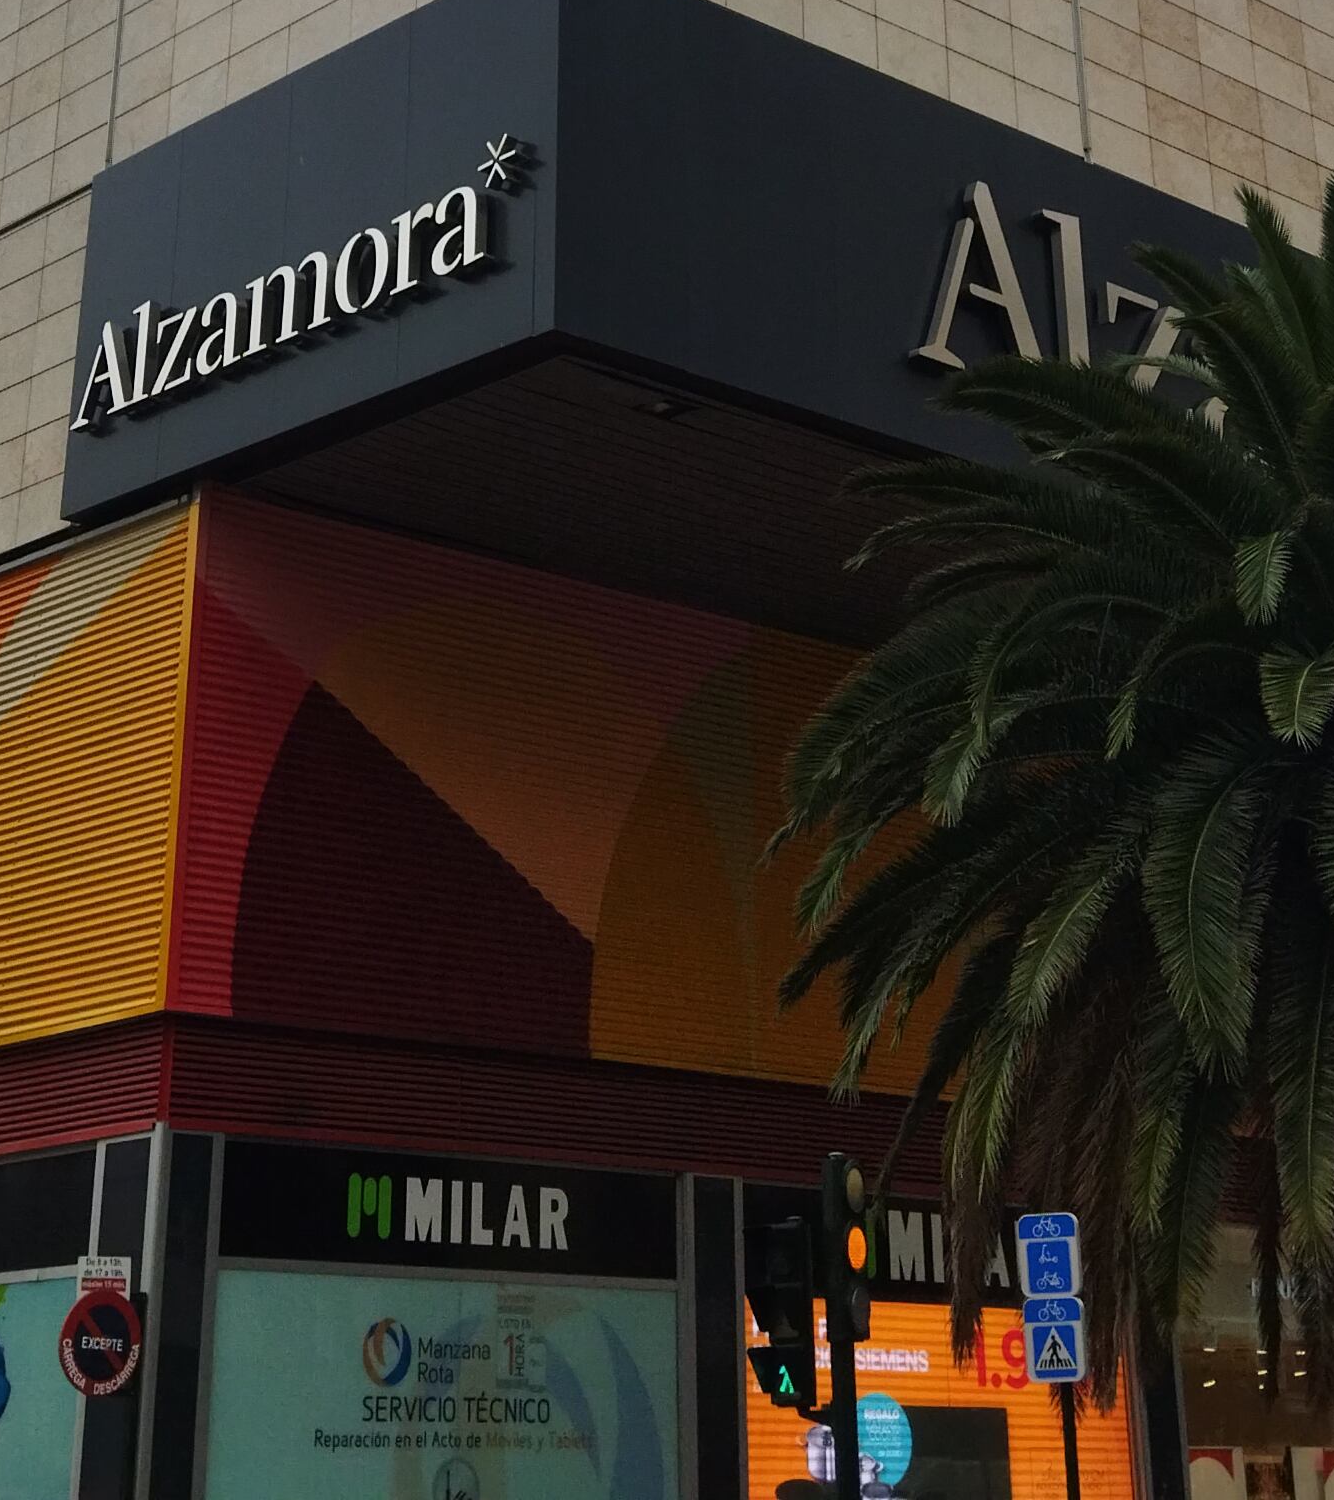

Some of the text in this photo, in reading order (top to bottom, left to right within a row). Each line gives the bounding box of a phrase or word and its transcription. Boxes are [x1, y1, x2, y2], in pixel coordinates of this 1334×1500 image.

[403, 1176, 569, 1251] MILAR
[81, 1336, 124, 1352] EXCEPTE
[417, 1337, 491, 1360] Manzana
[854, 1348, 929, 1373] SIEMENS
[417, 1362, 454, 1384] Rota
[361, 1391, 551, 1424] SERVICIO TÉCNICO
[313, 1429, 390, 1452] Reparación
[394, 1435, 412, 1448] en
[415, 1430, 427, 1448] el
[431, 1431, 462, 1448] Acto
[466, 1431, 482, 1448] de
